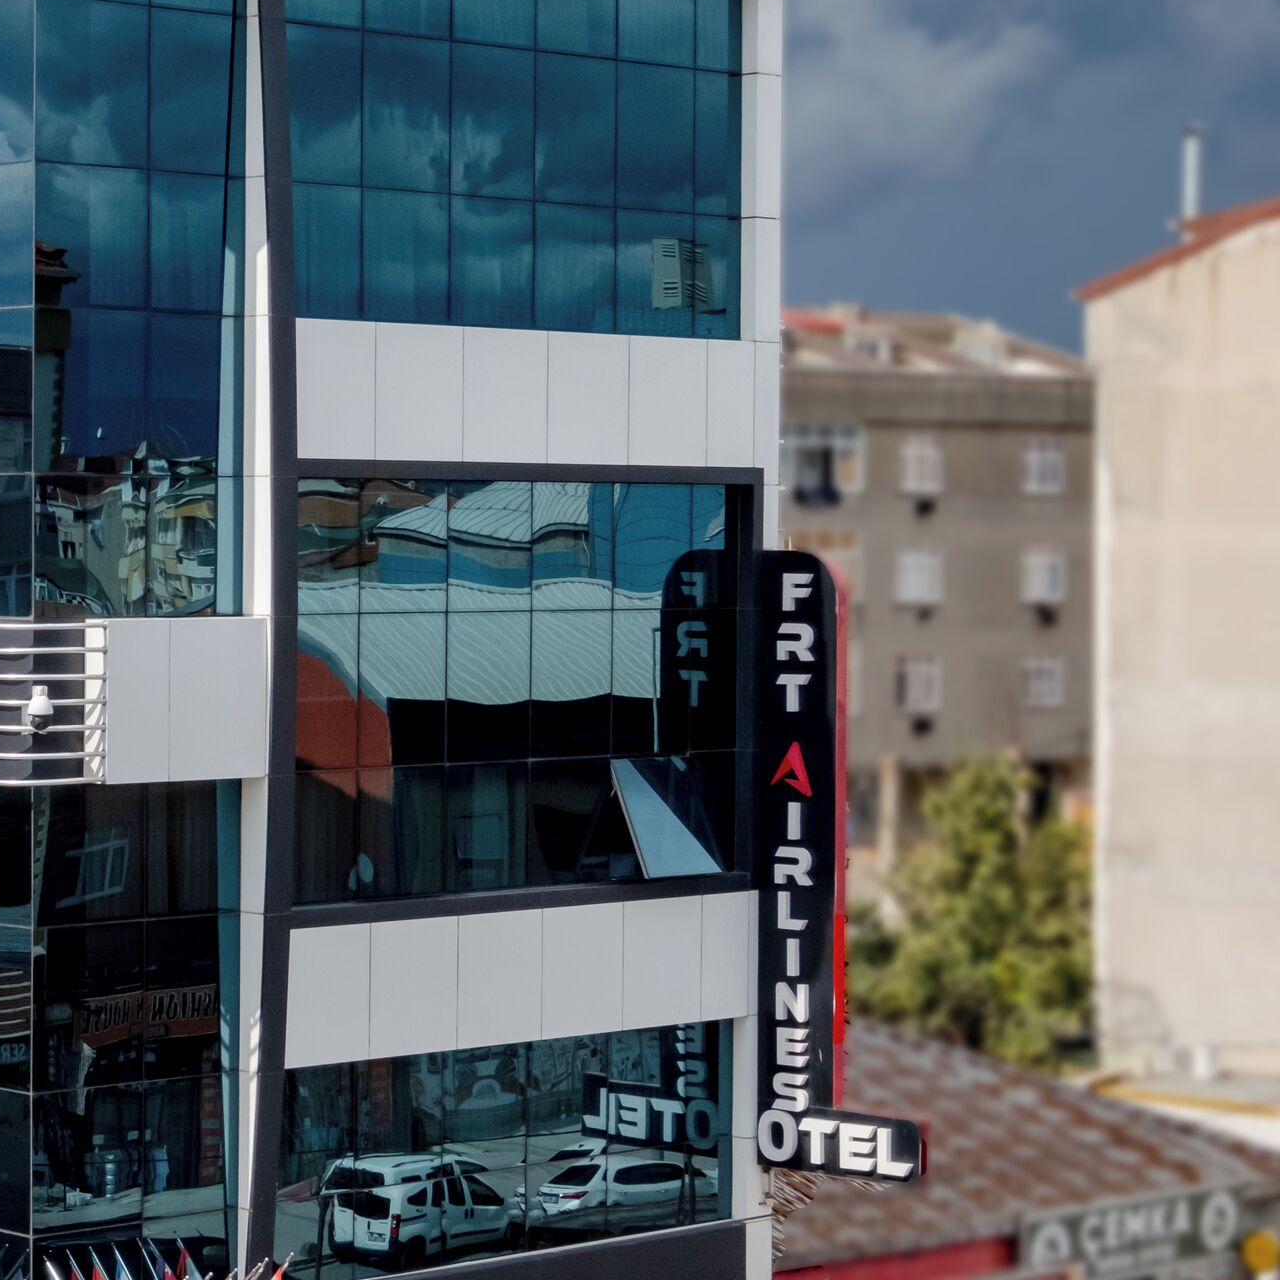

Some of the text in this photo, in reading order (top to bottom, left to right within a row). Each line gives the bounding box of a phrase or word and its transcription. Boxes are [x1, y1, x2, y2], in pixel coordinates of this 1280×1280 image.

[770, 573, 815, 1113] FRT AIRLINES
[757, 1110, 915, 1178] OTEL
